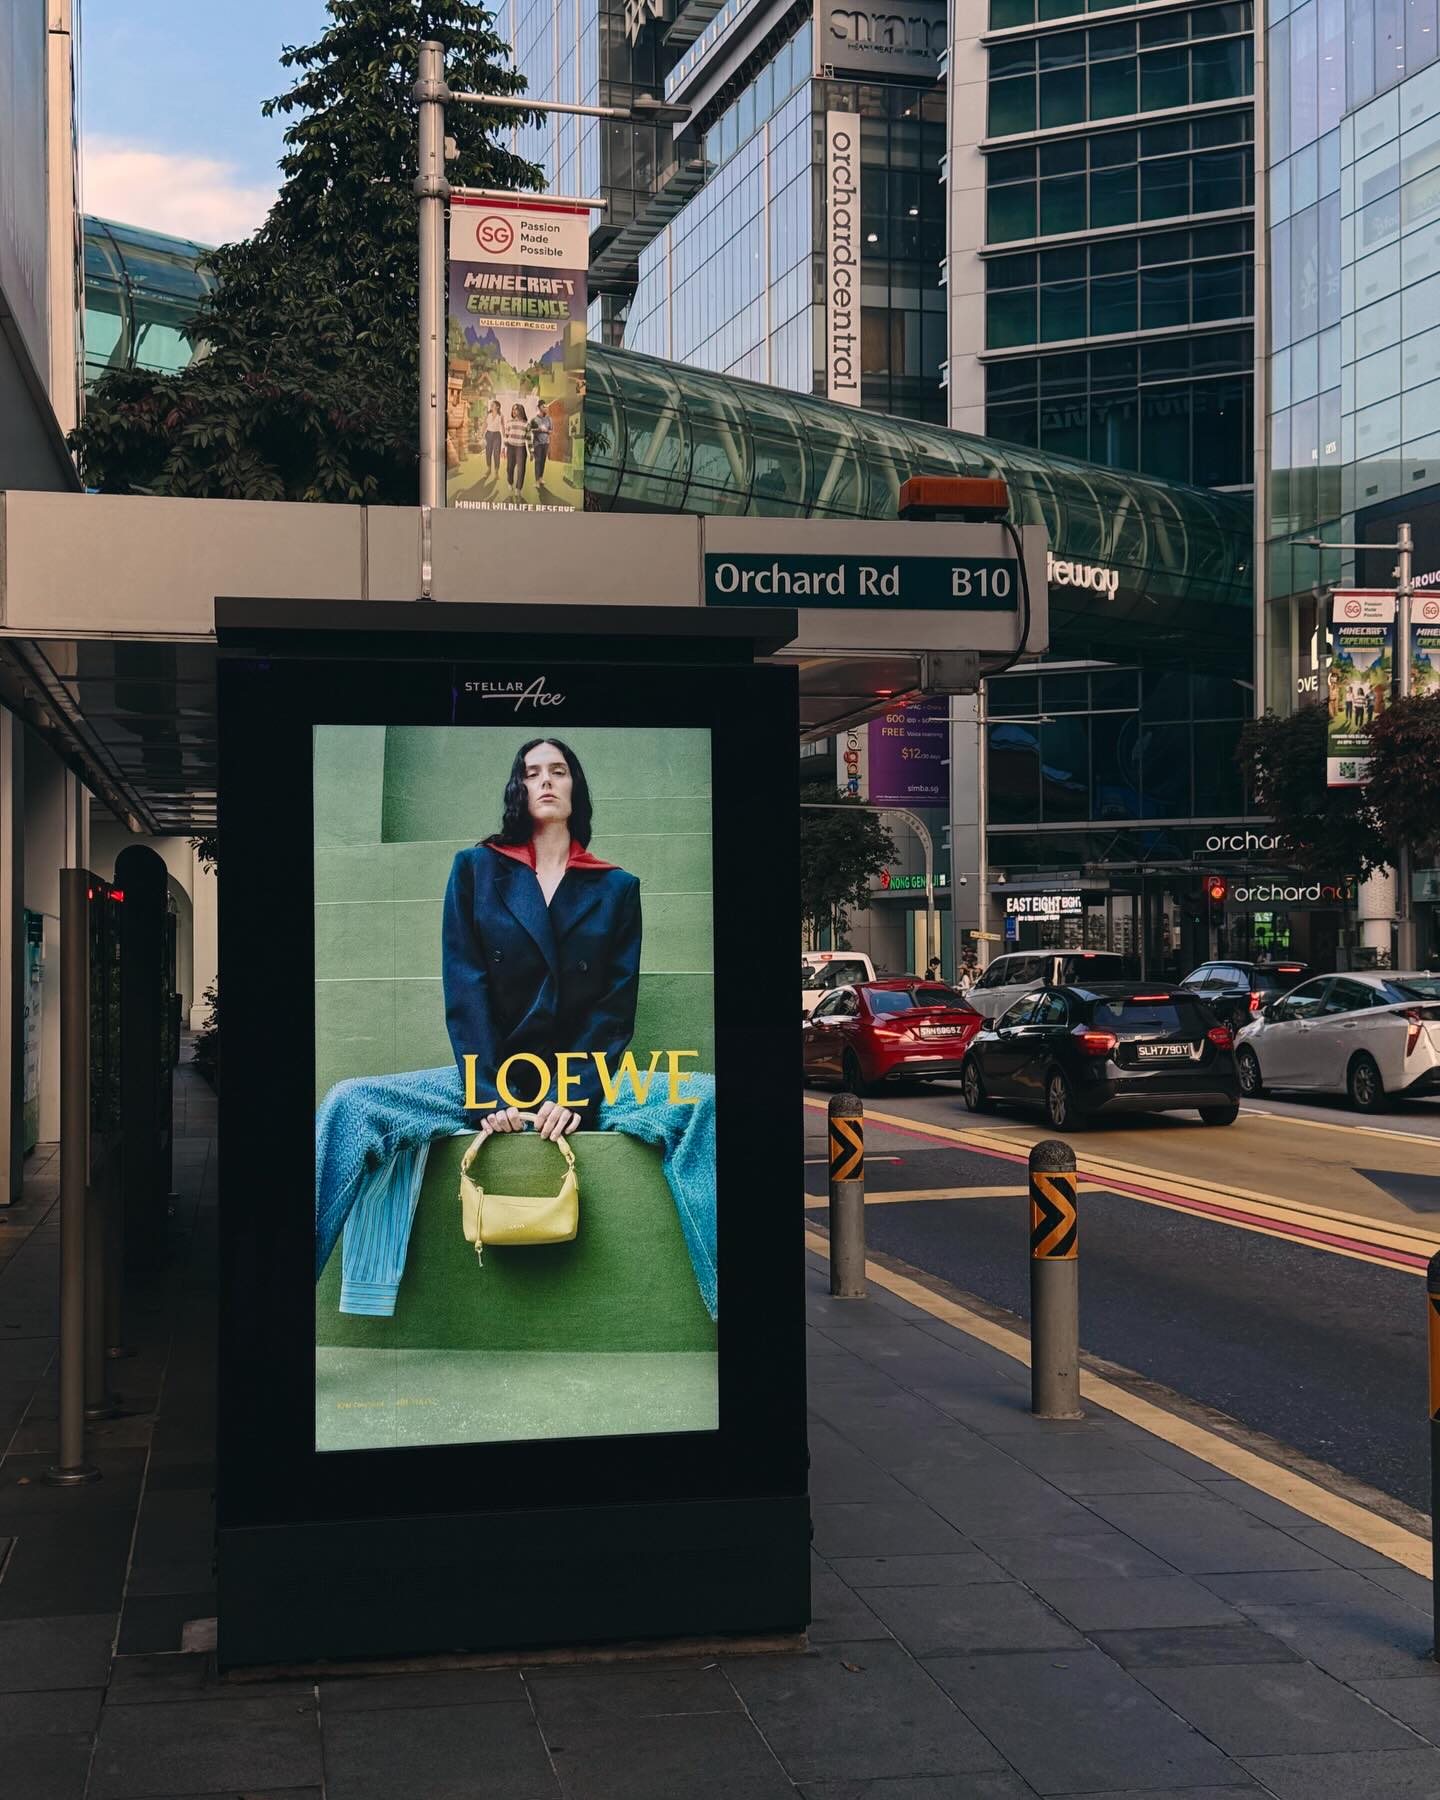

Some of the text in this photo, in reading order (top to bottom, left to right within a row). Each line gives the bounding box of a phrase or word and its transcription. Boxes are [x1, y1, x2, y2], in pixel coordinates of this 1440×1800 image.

[520, 221, 560, 232] Passion
[481, 226, 509, 243] SG
[520, 233, 549, 243] Made
[520, 245, 563, 256] Possible
[832, 131, 857, 390] orchardcentral
[464, 272, 575, 295] MINECRAFT
[466, 294, 570, 318] EXPERIENCE
[481, 319, 556, 330] VILLAGER RESCUE
[455, 500, 490, 510] MANDAI
[492, 502, 534, 512] WILDLIFE
[714, 562, 1011, 597] Orchard Rd B10
[465, 676, 566, 712] STELLAR Ace
[886, 714, 905, 723] 600
[882, 727, 905, 737] FREE
[907, 785, 939, 794] simba.sg
[890, 876, 910, 889] NONG
[911, 874, 930, 888] GEN
[1006, 897, 1032, 912] EAST
[1033, 896, 1061, 912] EIGHT
[1138, 1045, 1188, 1056] SLH7790Y
[462, 1050, 700, 1109] LOEWE
